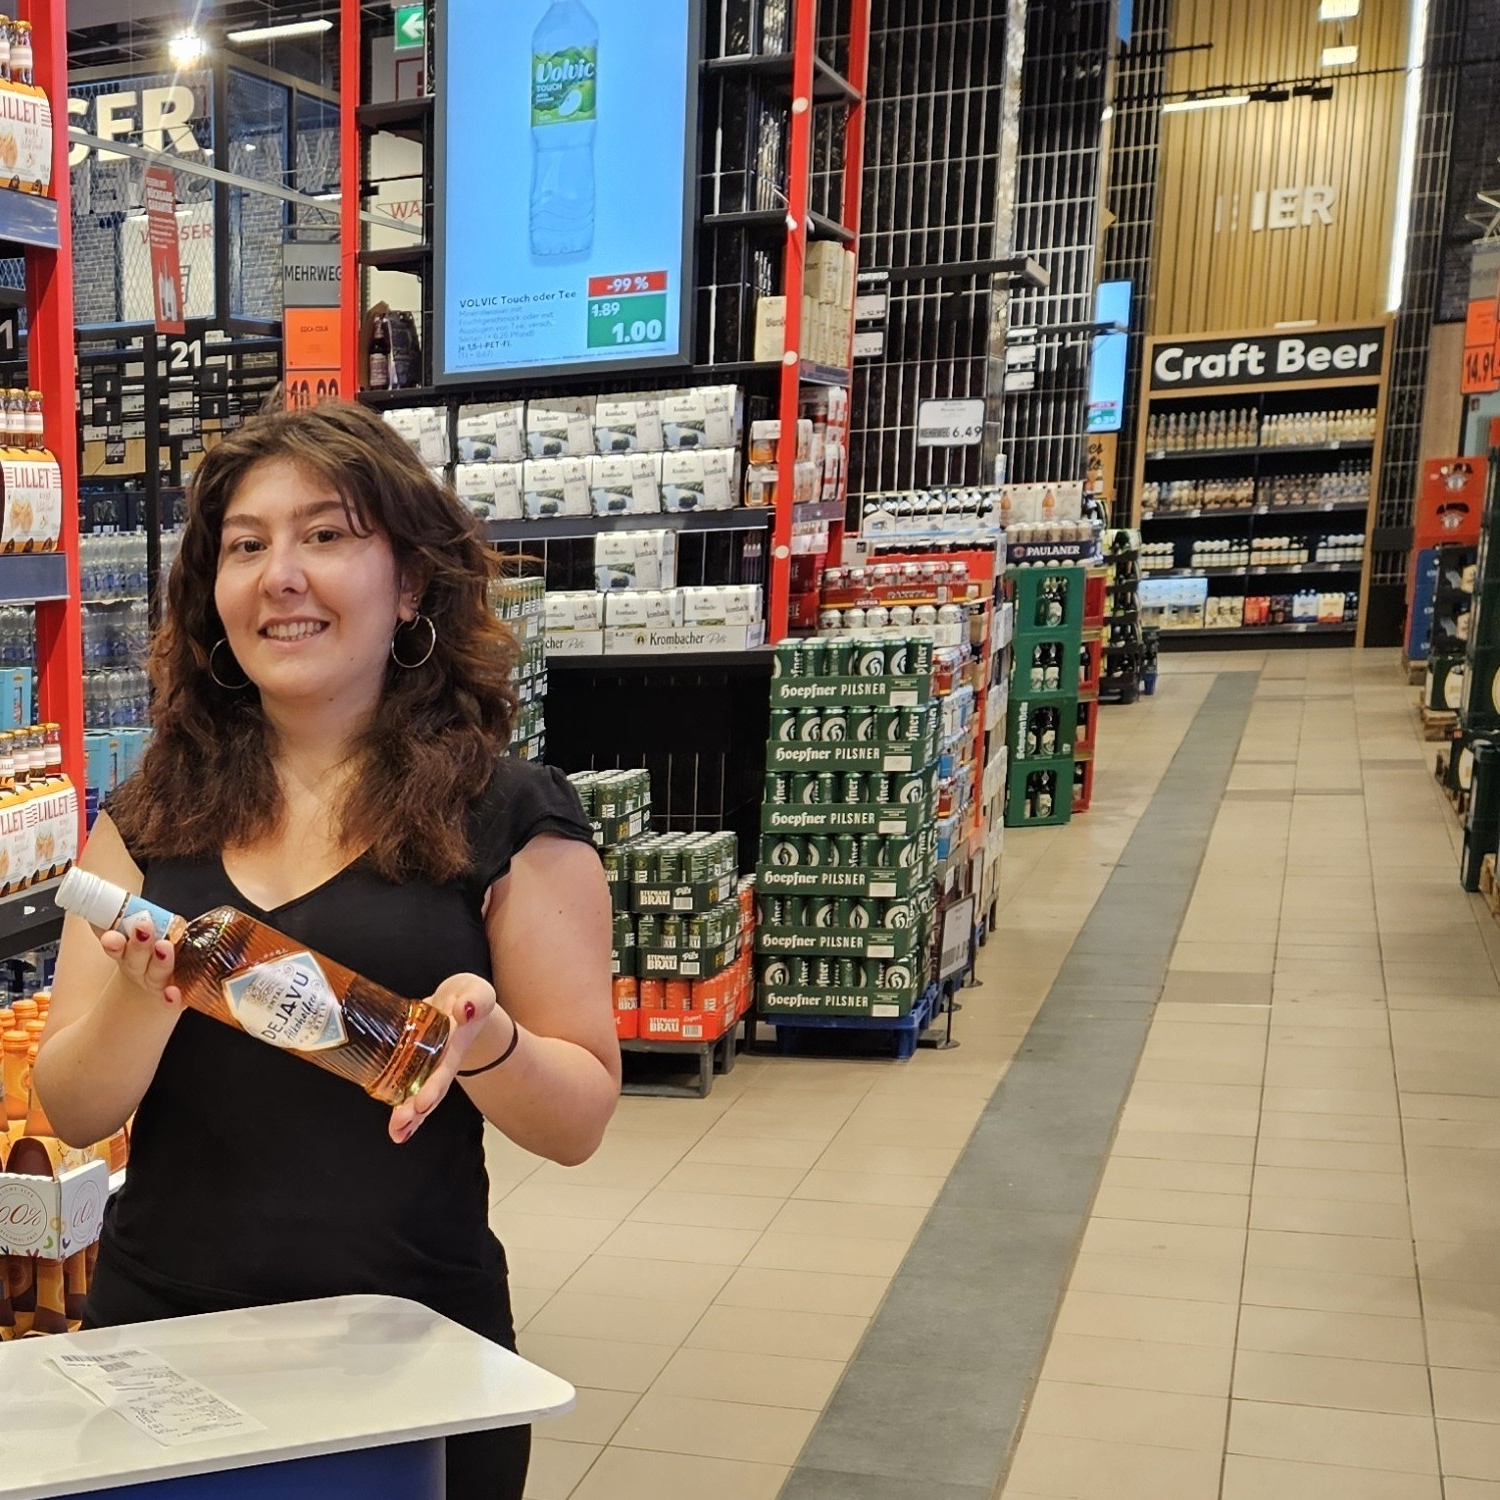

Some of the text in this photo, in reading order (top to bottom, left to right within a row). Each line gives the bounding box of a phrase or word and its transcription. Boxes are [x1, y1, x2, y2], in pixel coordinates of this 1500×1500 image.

[536, 58, 595, 84] Volvic
[459, 289, 577, 309] VOLVIC Touch oder Tee
[611, 319, 662, 344] 1.00
[170, 340, 202, 369] 21
[1154, 338, 1378, 383] Craft Beer
[952, 425, 983, 439] 6.49
[14, 467, 51, 489] LILLET
[1026, 544, 1080, 557] PAULANER
[649, 632, 705, 647] Krombacher
[780, 683, 886, 699] Hoepfner PILSNER
[775, 747, 880, 762] Hoepfner PILSNER
[38, 794, 70, 823] LILLET
[771, 811, 875, 827] Hoepfner PILSNER
[764, 870, 866, 886] Hoepfner PILSNER
[762, 933, 864, 949] Hoepfner PILSNER
[767, 992, 869, 1008] Hoepfner PILSNER
